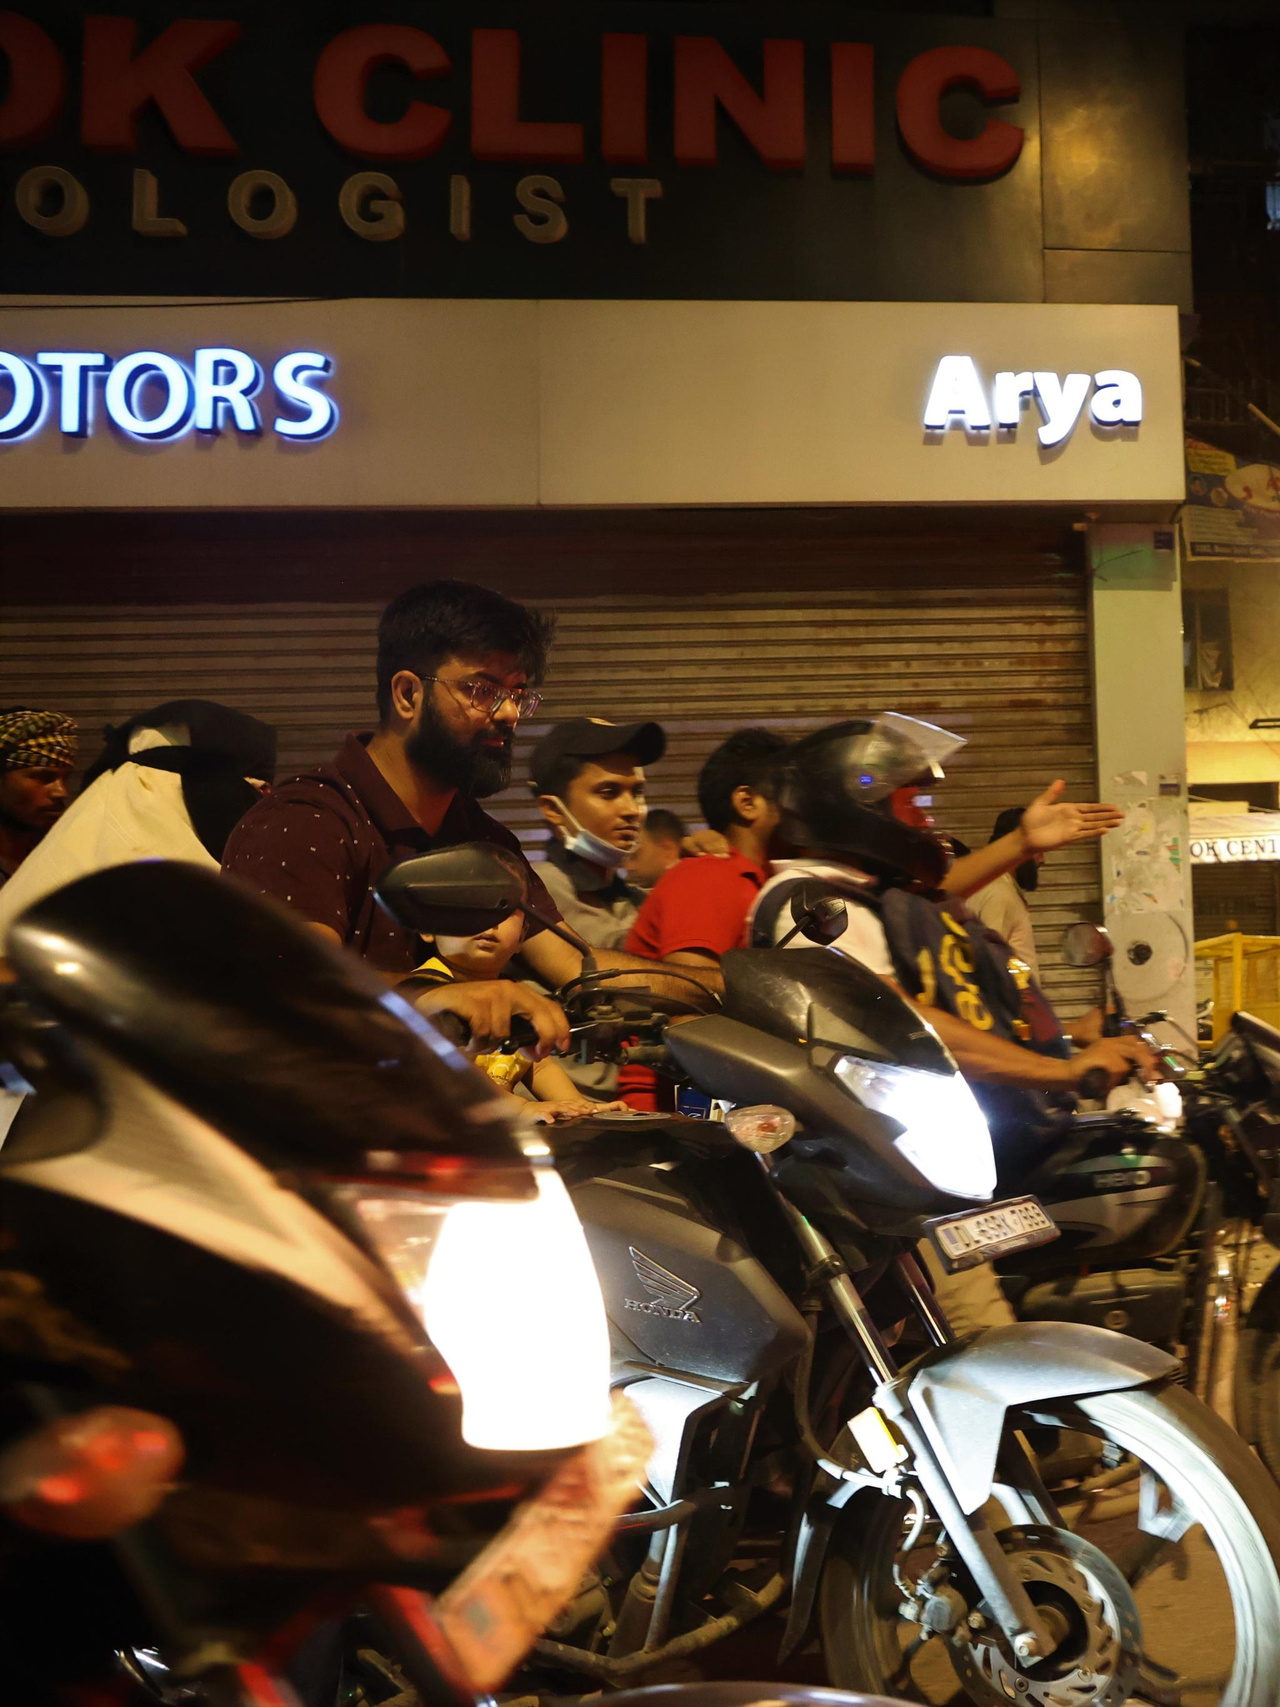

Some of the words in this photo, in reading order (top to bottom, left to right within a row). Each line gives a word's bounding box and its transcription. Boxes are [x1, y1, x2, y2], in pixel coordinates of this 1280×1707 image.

[313, 24, 1025, 178] CLINIC
[15, 165, 663, 245] OLOGIST
[923, 355, 1143, 447] Arya
[624, 1298, 700, 1323] HONDA
